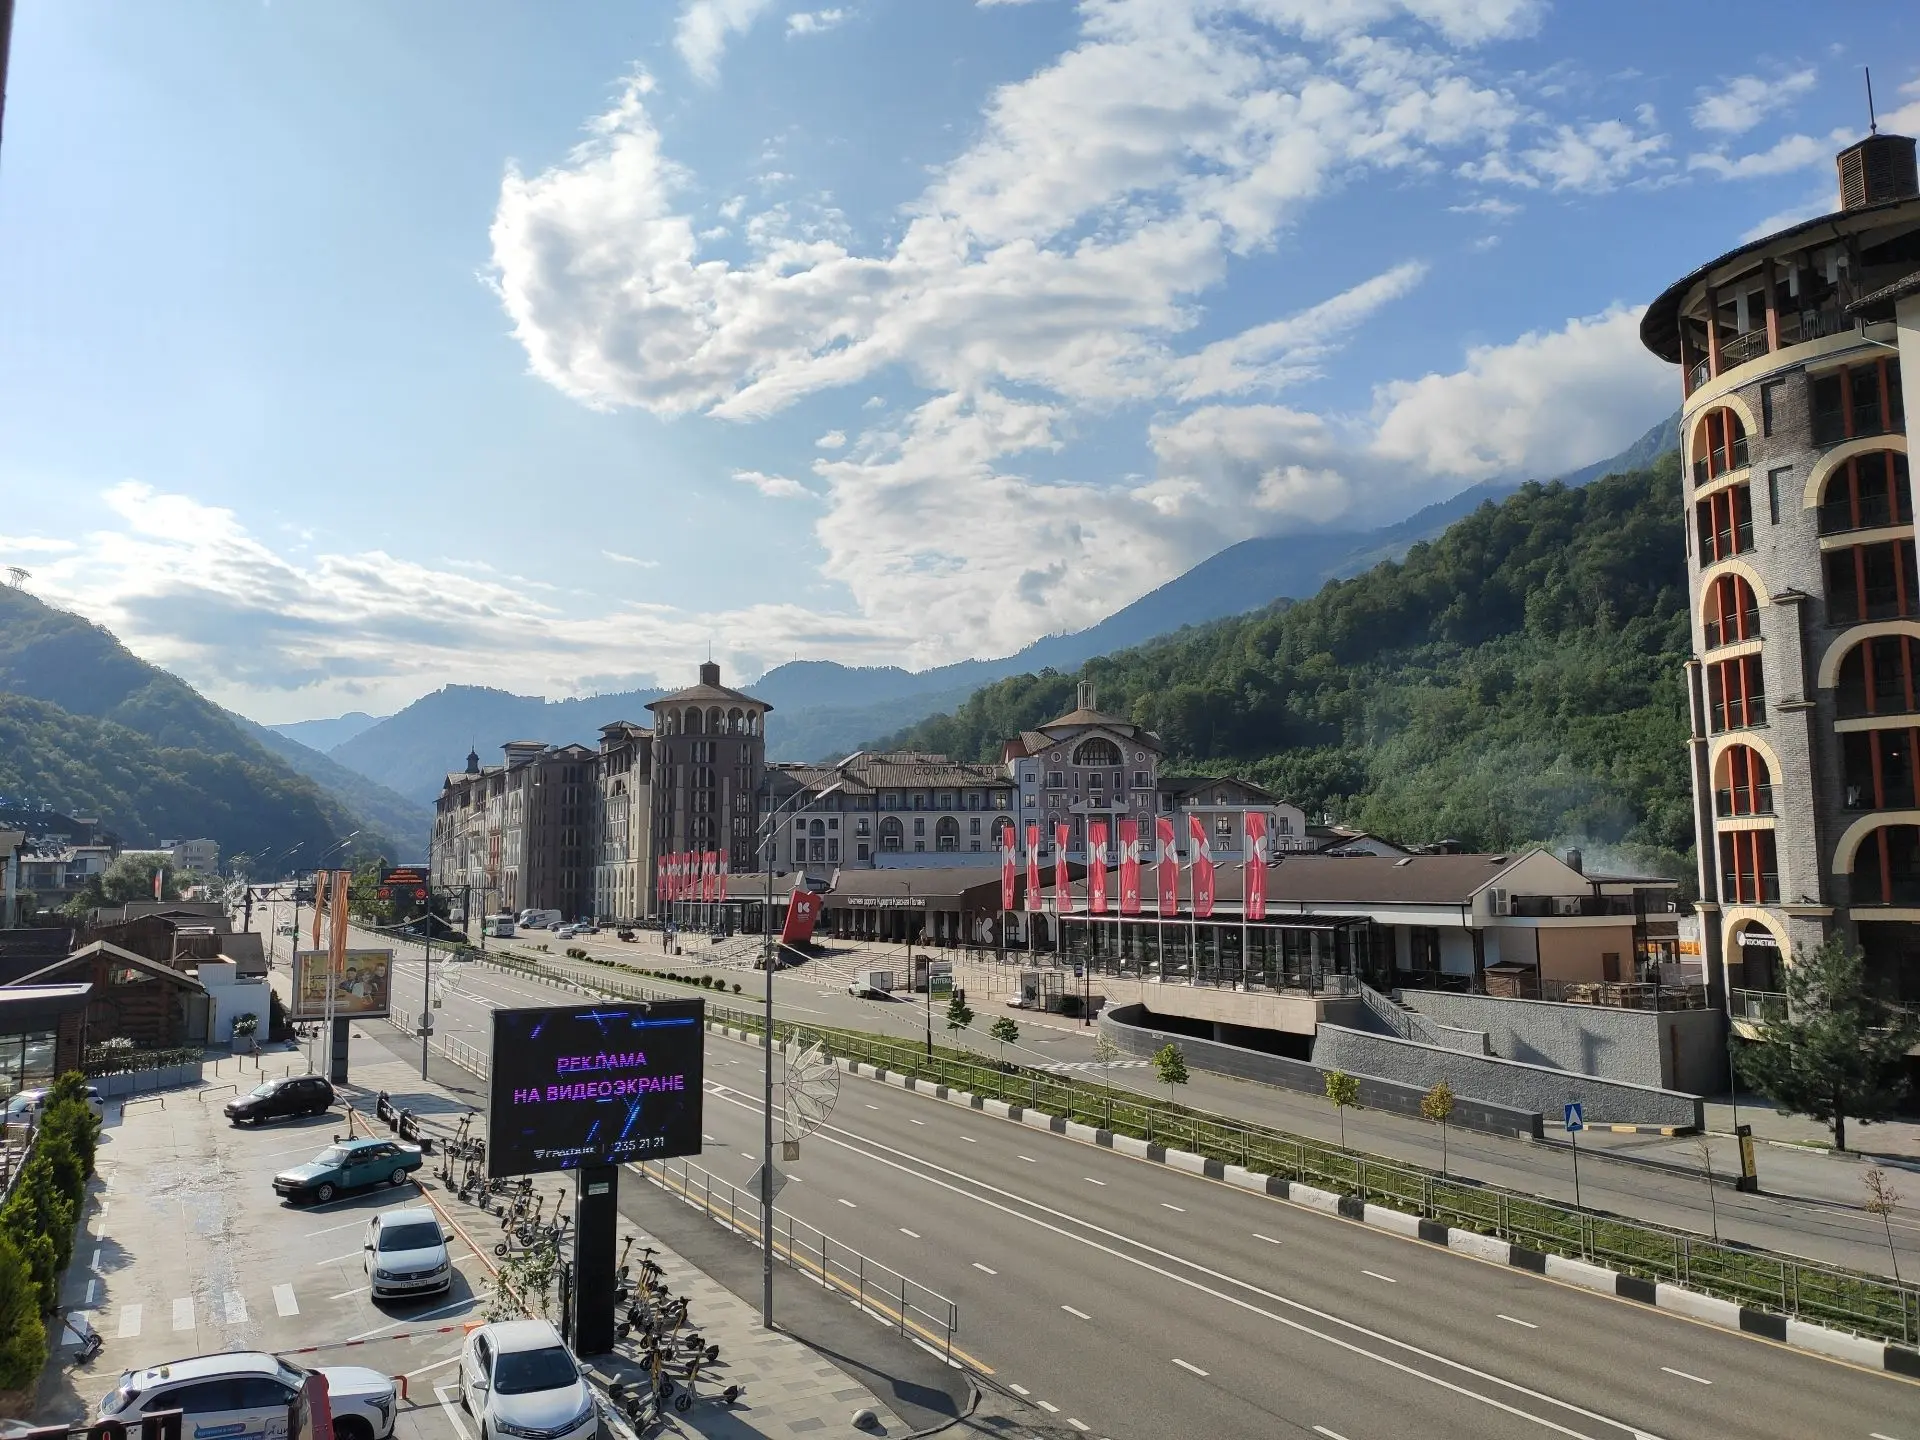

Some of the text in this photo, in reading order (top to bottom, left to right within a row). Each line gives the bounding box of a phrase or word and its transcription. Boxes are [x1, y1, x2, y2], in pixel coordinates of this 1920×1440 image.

[932, 977, 951, 985] АПТЕКА
[557, 1052, 647, 1071] РЕКЛАМА
[514, 1074, 685, 1104] НА ВИДЕОЭКРАНЕ
[614, 1140, 636, 1152] 235
[639, 1138, 650, 1149] 21
[654, 1136, 665, 1148] 21
